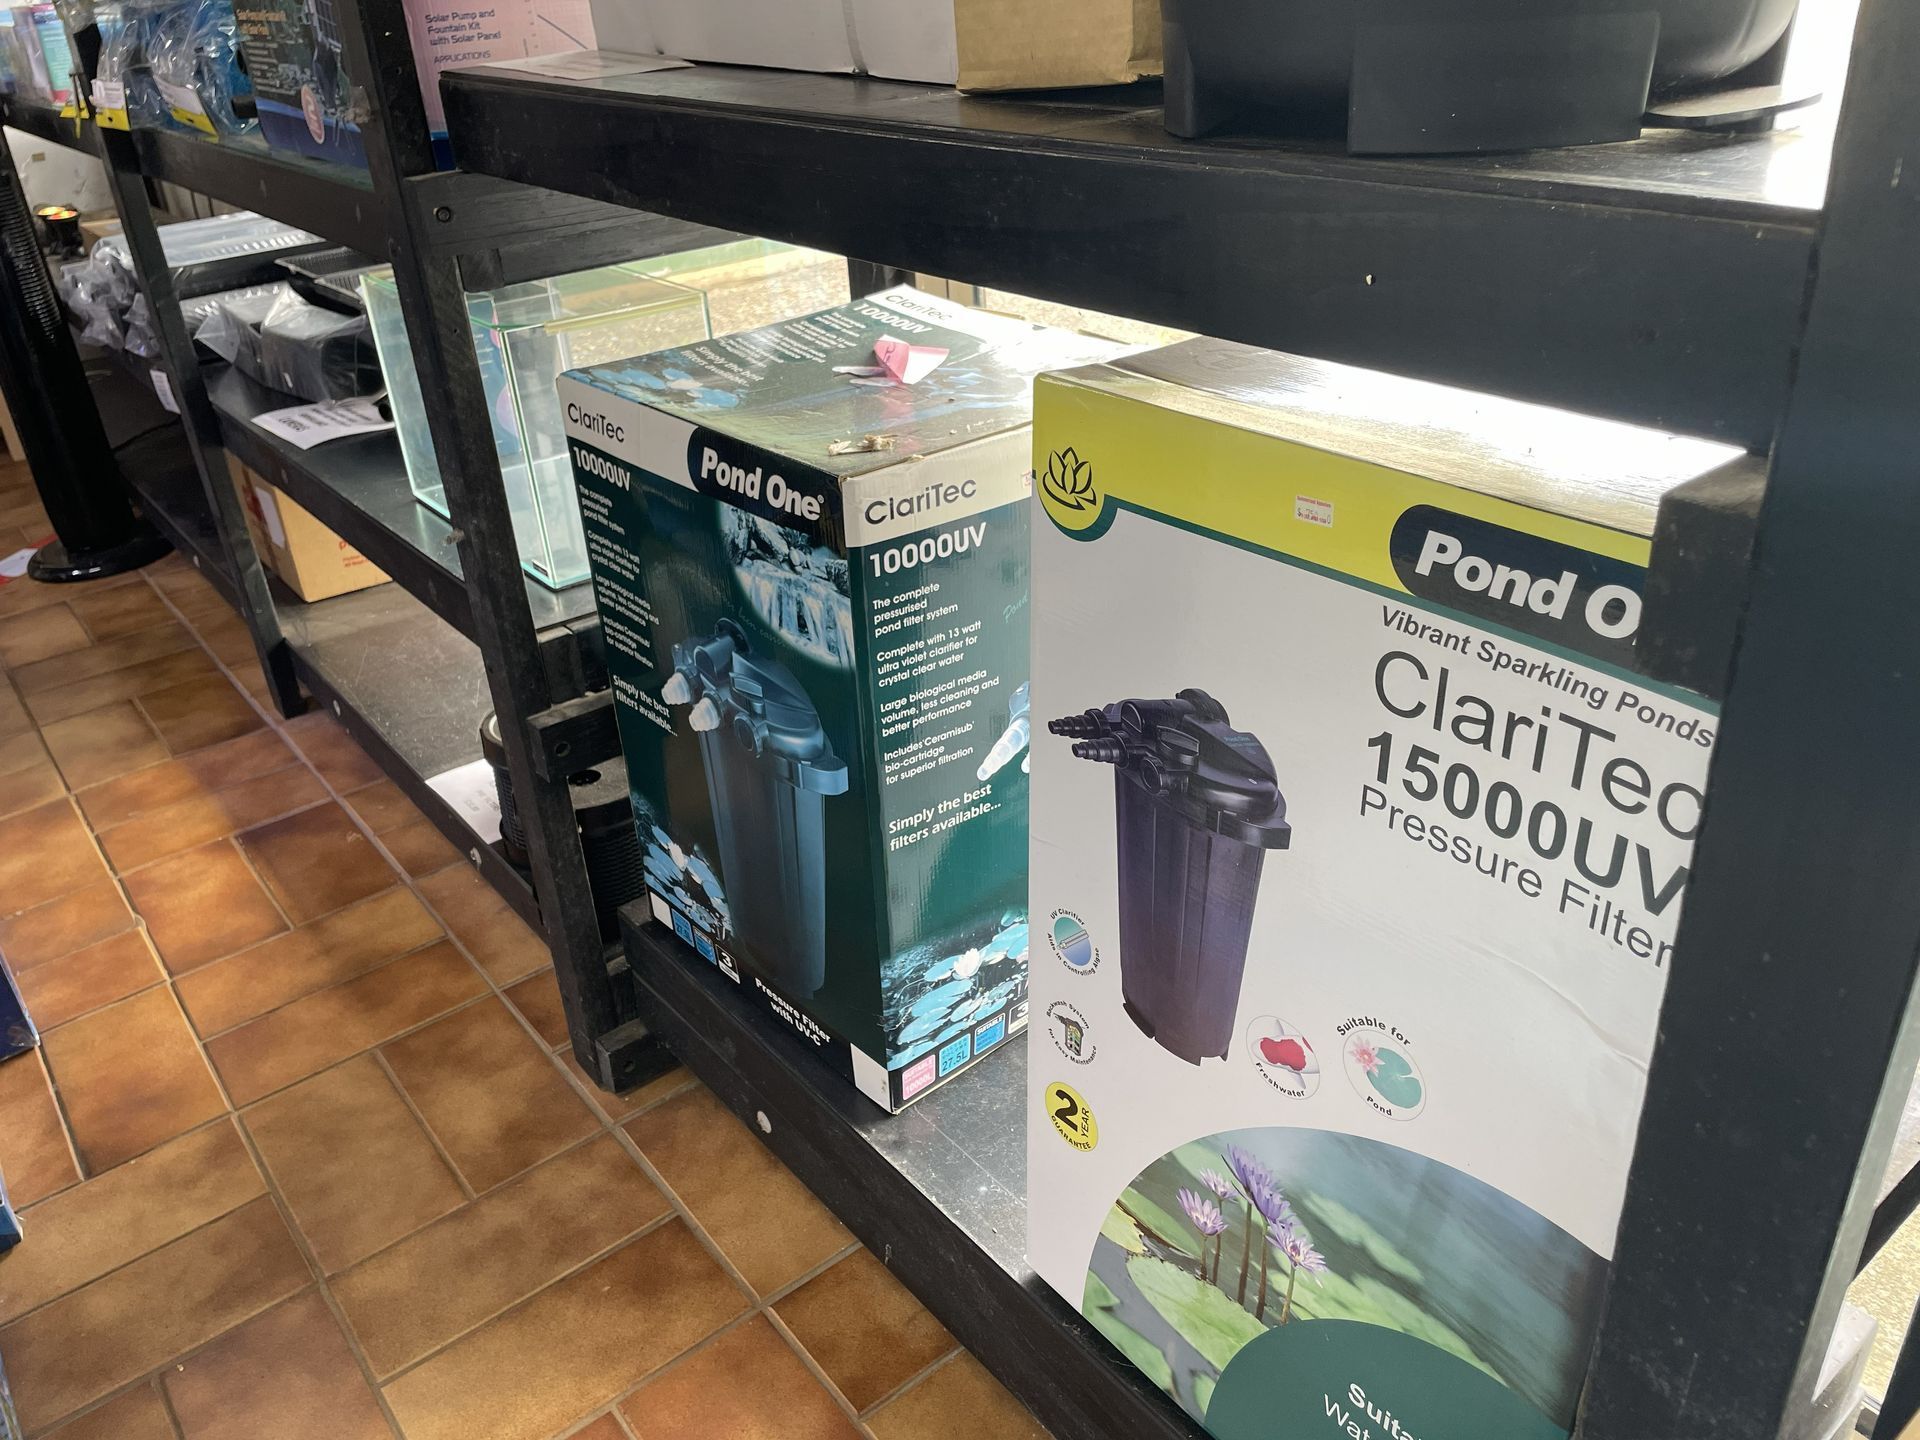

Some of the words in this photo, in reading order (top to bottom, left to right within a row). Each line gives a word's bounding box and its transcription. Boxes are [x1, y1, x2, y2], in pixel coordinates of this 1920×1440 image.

[425, 12, 449, 23] Solar
[452, 11, 477, 21] Pump
[479, 9, 495, 18] and
[427, 23, 466, 34] Fountain
[468, 22, 480, 31] Kit
[430, 35, 450, 46] with
[451, 34, 475, 44] Solar
[477, 31, 501, 42] Panel
[433, 50, 491, 64] APPLICATIONS
[853, 303, 933, 333] 10000UV
[886, 295, 952, 320] ClariTec
[567, 402, 625, 443] ClariTec
[573, 446, 630, 492] 10000UV
[701, 446, 762, 500] Pond
[864, 479, 977, 525] ClariTec
[869, 522, 987, 577] 10000UV
[873, 597, 890, 610] The
[893, 583, 940, 604] complete
[1414, 530, 1578, 620] Pond
[1585, 584, 1643, 646] O
[874, 599, 927, 625] pressurised
[874, 621, 901, 638] pond
[903, 612, 924, 628] filter
[926, 603, 958, 621] system
[876, 639, 925, 662] Complete
[927, 633, 946, 646] with
[949, 628, 960, 639] 13
[961, 620, 982, 635] watt
[878, 661, 900, 675] ultra
[901, 651, 927, 666] violet
[929, 640, 963, 658] clarifier
[965, 635, 978, 646] for
[878, 669, 910, 688] crystal
[912, 662, 936, 676] clear
[938, 652, 964, 667] water
[1382, 605, 1471, 655] Vibrant
[1476, 640, 1611, 710] Sparkling
[1615, 691, 1714, 748] Ponds
[613, 674, 639, 699] Simply
[639, 690, 653, 707] the
[653, 698, 671, 718] best
[615, 689, 638, 711] filters
[880, 696, 907, 713] Large
[909, 679, 955, 703] biological
[957, 670, 987, 686] media
[881, 706, 919, 725] volume,
[921, 698, 938, 711] less
[939, 685, 980, 705] cleaning
[981, 676, 1000, 690] and
[881, 721, 910, 737] better
[912, 700, 972, 728] performance
[884, 740, 923, 762] Includes
[884, 745, 945, 773] bio-cartridge
[1375, 650, 1704, 840] ClariTec
[885, 773, 899, 786] for
[900, 759, 937, 781] superior
[938, 746, 974, 766] filtration
[888, 808, 935, 834] Simply
[937, 797, 960, 814] the
[963, 784, 992, 804] best
[889, 828, 929, 851] filters
[931, 802, 1002, 834] available...
[1367, 731, 1690, 917] 15000UV
[1360, 784, 1542, 898] Pressure
[1558, 878, 1675, 967] Filter
[1050, 910, 1058, 920] UV
[1058, 908, 1085, 925] Clarifier
[721, 951, 733, 968] 3
[755, 977, 800, 1019] Pressure
[801, 1013, 831, 1043] Filter
[770, 1001, 794, 1025] with
[795, 1019, 821, 1046] UV-C
[1336, 1015, 1386, 1036] Suitable
[1391, 1027, 1411, 1046] for
[942, 1050, 967, 1072] 27.5L
[1255, 1061, 1306, 1097] Freshwater
[1054, 1089, 1078, 1132] 2
[1081, 1107, 1089, 1138] YEAR
[1366, 1095, 1393, 1116] Pond
[1051, 1115, 1091, 1149] GUARANTEE
[1348, 1383, 1421, 1440] Suita
